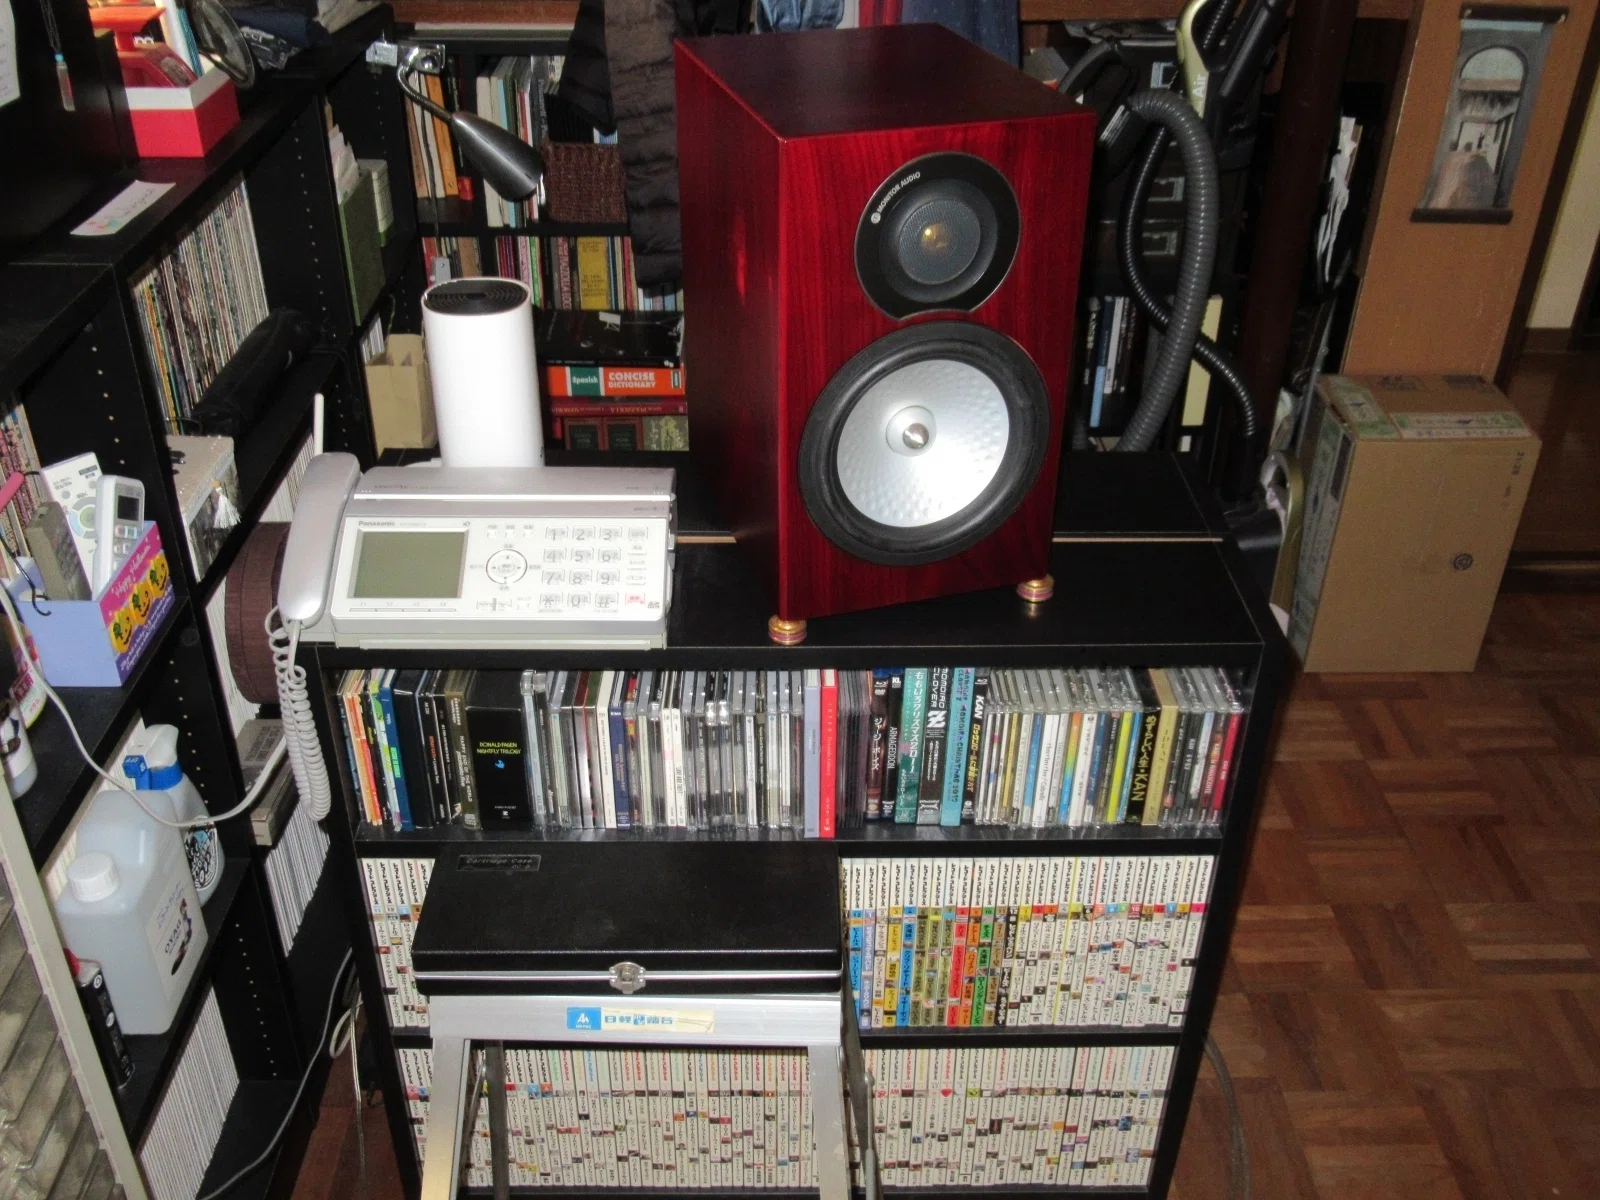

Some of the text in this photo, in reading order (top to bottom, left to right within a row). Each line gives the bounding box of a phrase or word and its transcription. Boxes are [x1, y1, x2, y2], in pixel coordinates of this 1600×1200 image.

[877, 171, 921, 214] MONITOR AUDIO
[572, 375, 598, 384] Spanish
[608, 372, 655, 380] CONCISE
[608, 380, 656, 388] DICTIONARY
[939, 668, 948, 708] MOMOIRO
[926, 710, 946, 728] Z
[974, 695, 984, 719] KAN
[872, 718, 882, 770] ジャージーボーイズ
[888, 727, 898, 768] ARMAGEDDON
